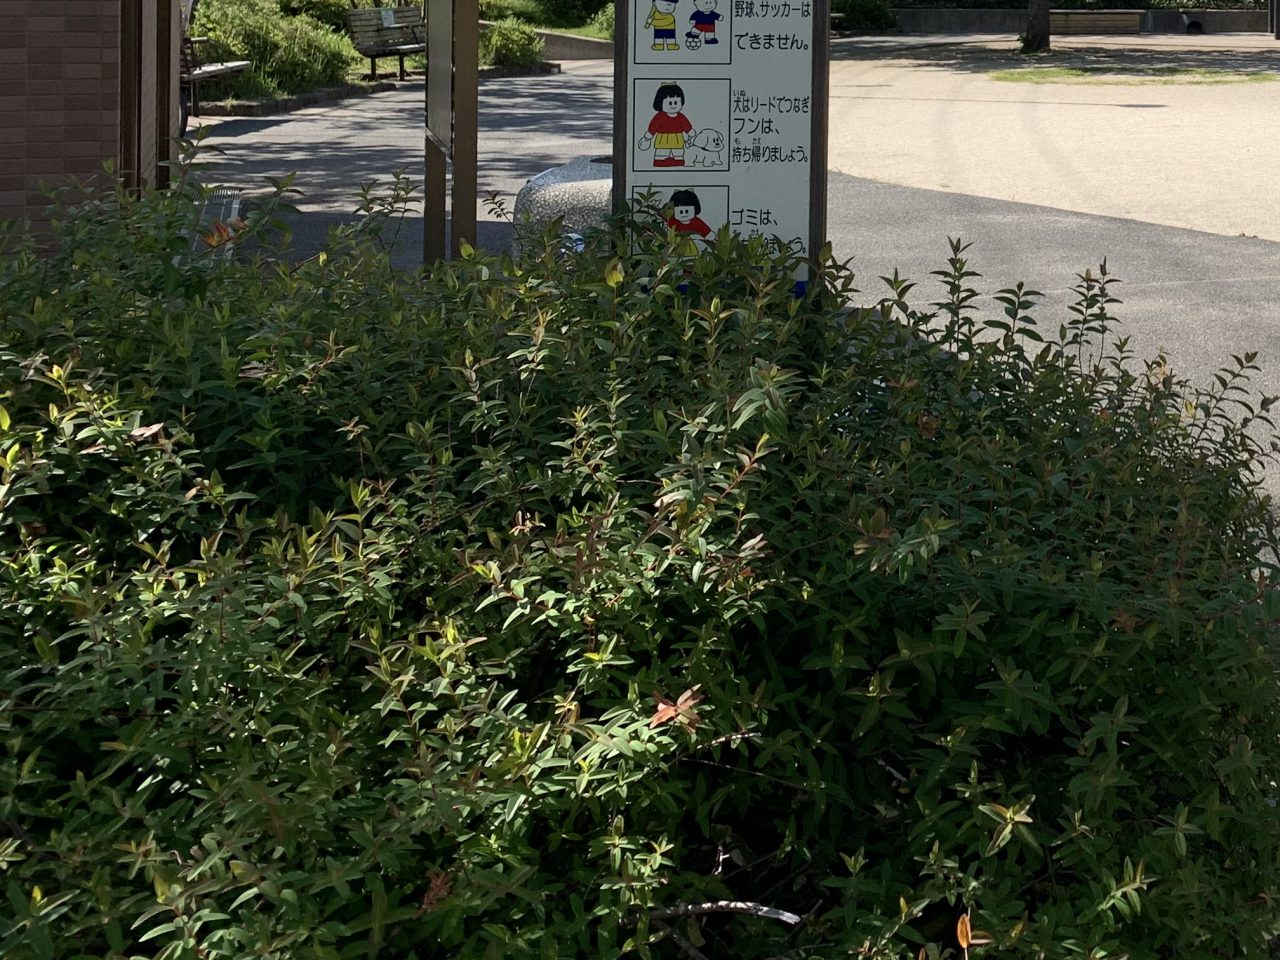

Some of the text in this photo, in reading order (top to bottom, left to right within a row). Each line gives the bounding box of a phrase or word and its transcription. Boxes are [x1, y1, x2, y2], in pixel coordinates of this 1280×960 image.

[735, 1, 810, 17] 野球、サッカーは
[735, 33, 808, 50] できません。
[734, 96, 809, 113] 犬はリードでつなぎ
[733, 117, 780, 134] フンは、
[732, 146, 808, 162] 持ち帰りましょう。
[731, 209, 779, 226] ゴミは、
